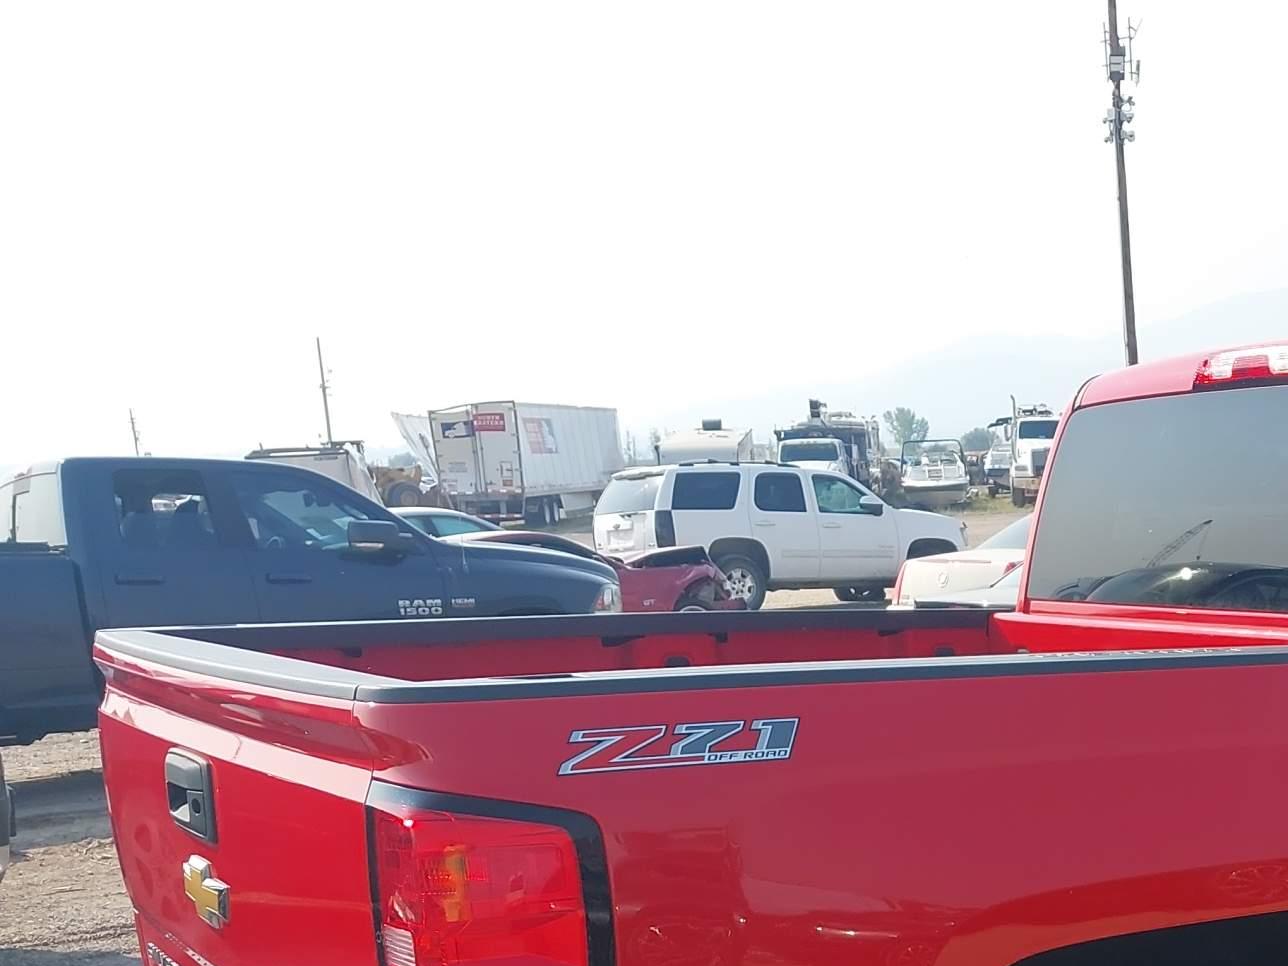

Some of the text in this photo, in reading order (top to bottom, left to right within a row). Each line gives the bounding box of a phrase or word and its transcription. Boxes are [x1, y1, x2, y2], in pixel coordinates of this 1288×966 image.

[398, 599, 442, 608] RAM
[400, 607, 443, 616] 1500
[557, 717, 800, 776] Z71
[706, 749, 788, 762] OFF ROAD
